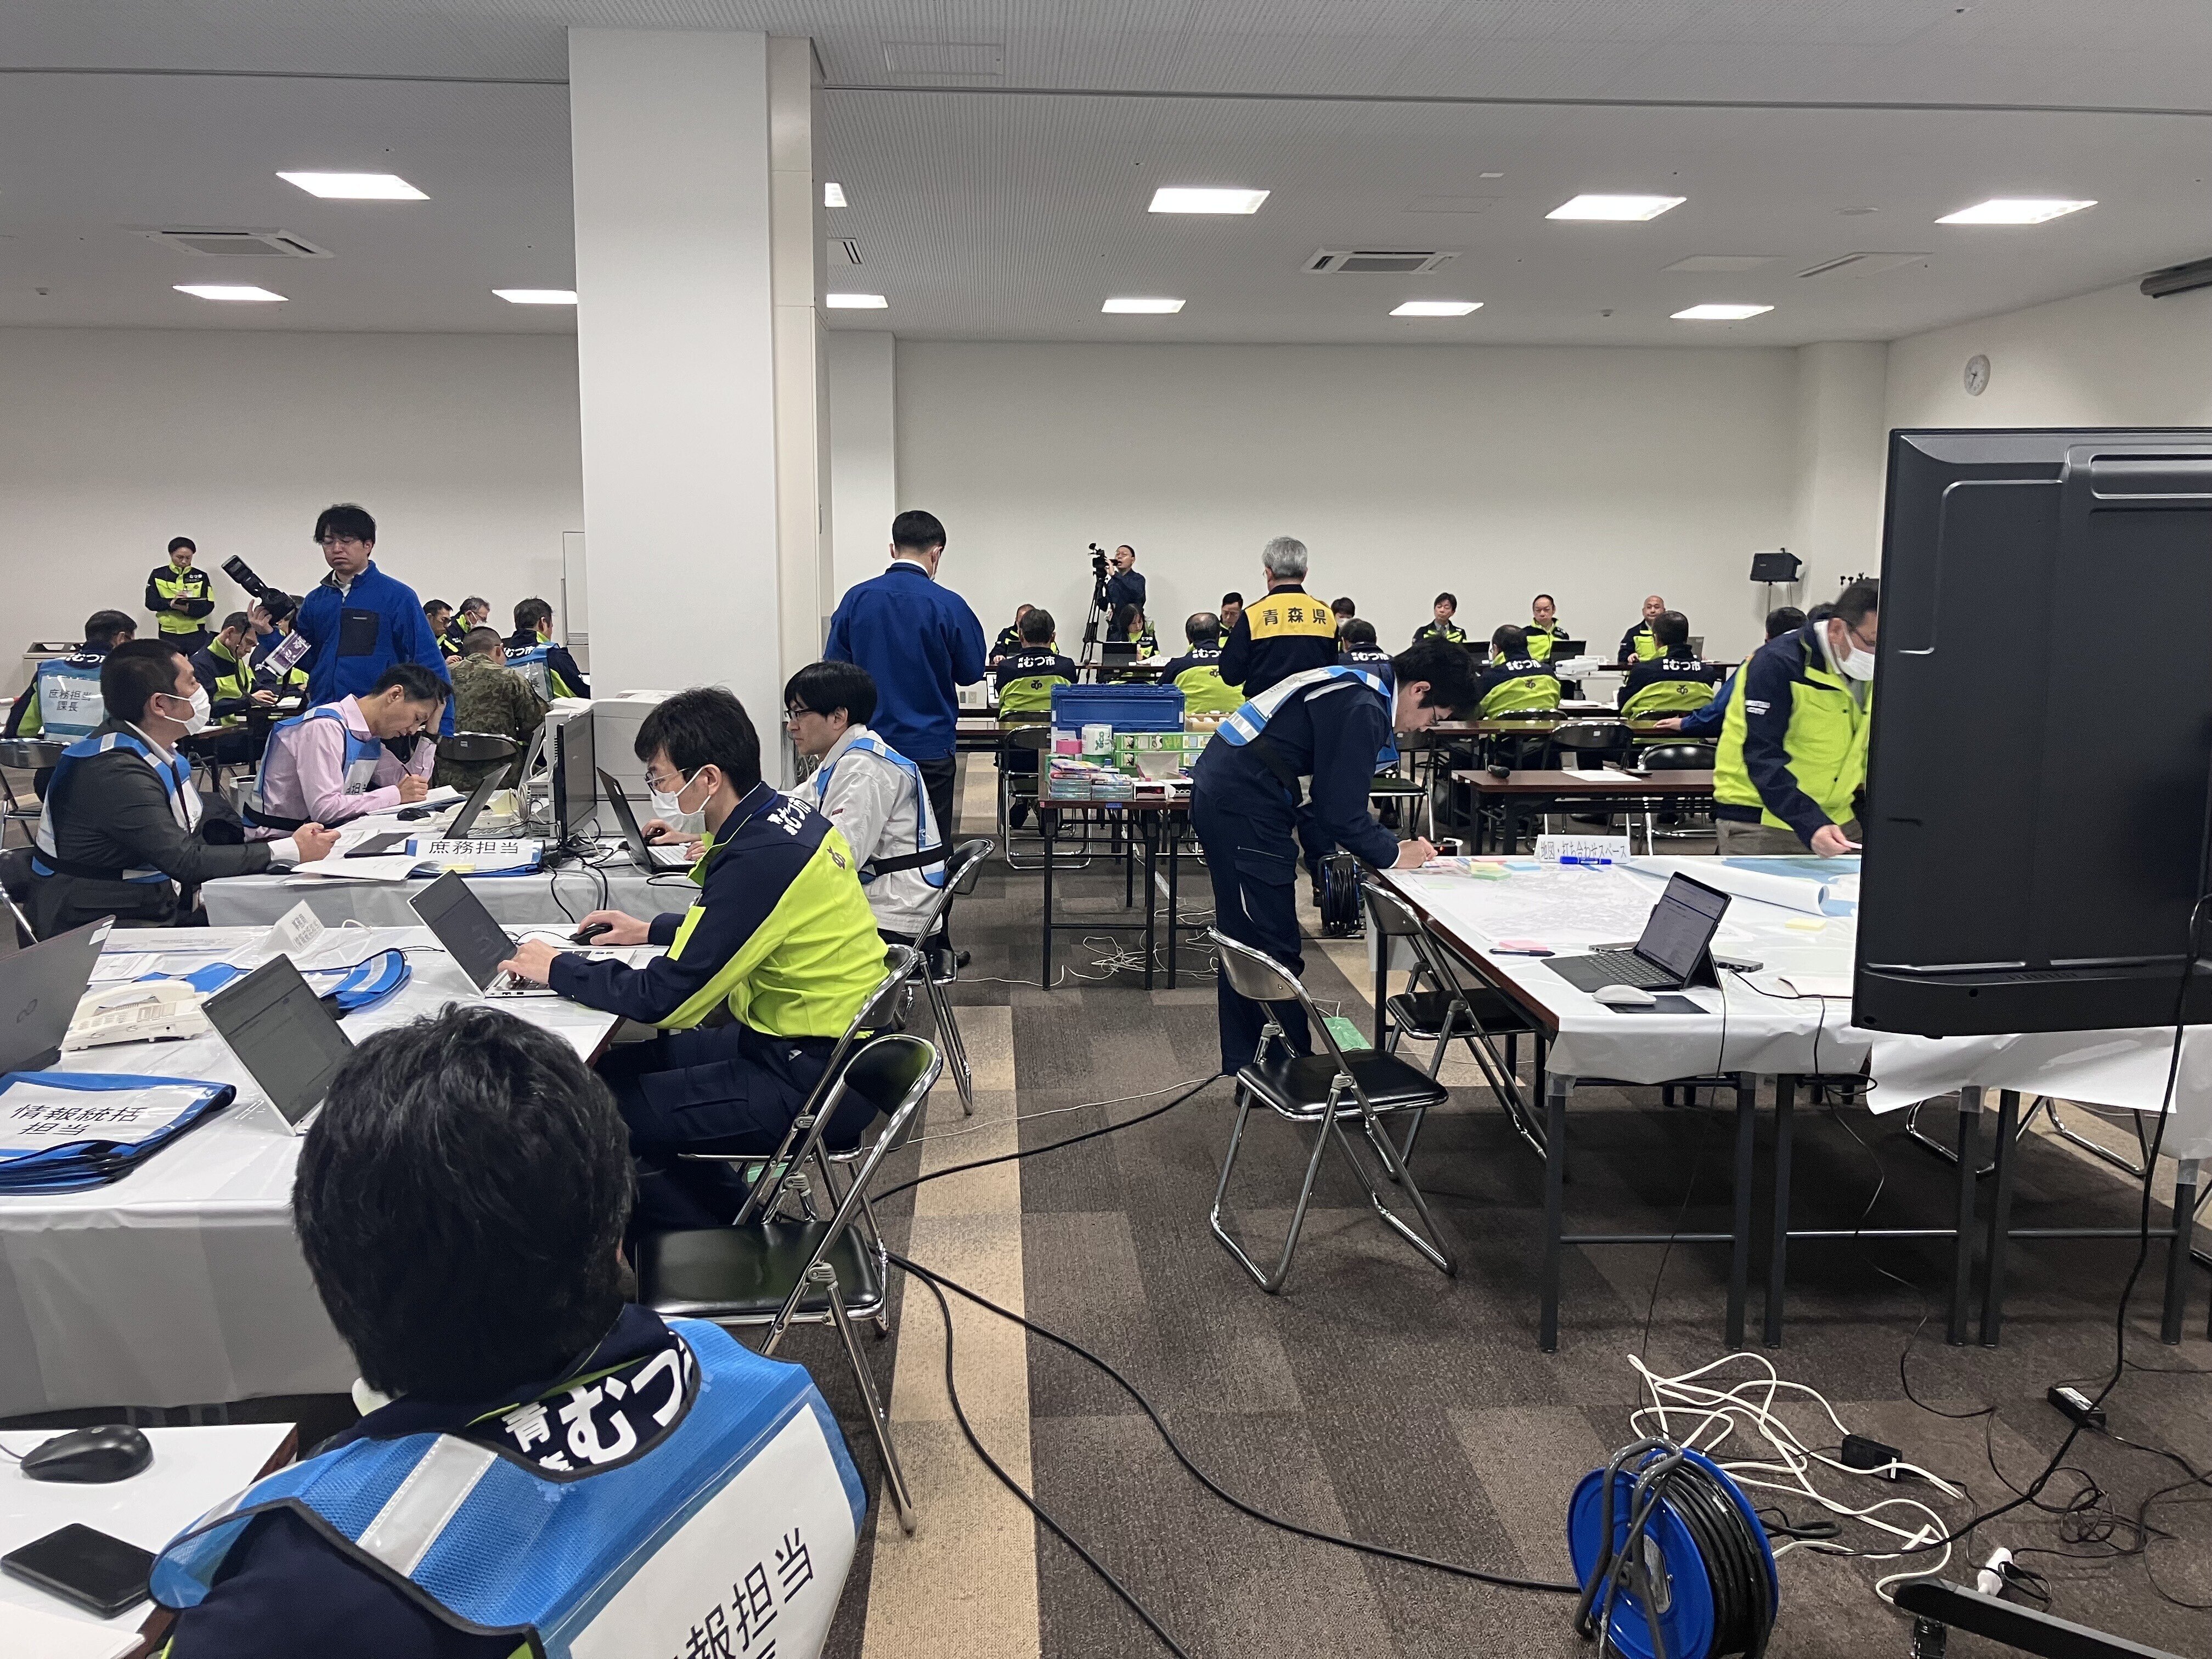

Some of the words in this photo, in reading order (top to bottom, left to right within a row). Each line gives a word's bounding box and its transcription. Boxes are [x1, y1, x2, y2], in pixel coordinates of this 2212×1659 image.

[1263, 607, 1326, 625] 青森県
[428, 840, 518, 855] 庶務担当
[9, 1104, 149, 1122] 情報統括
[16, 1122, 91, 1136] 担当
[673, 1527, 814, 1659] 報担当
